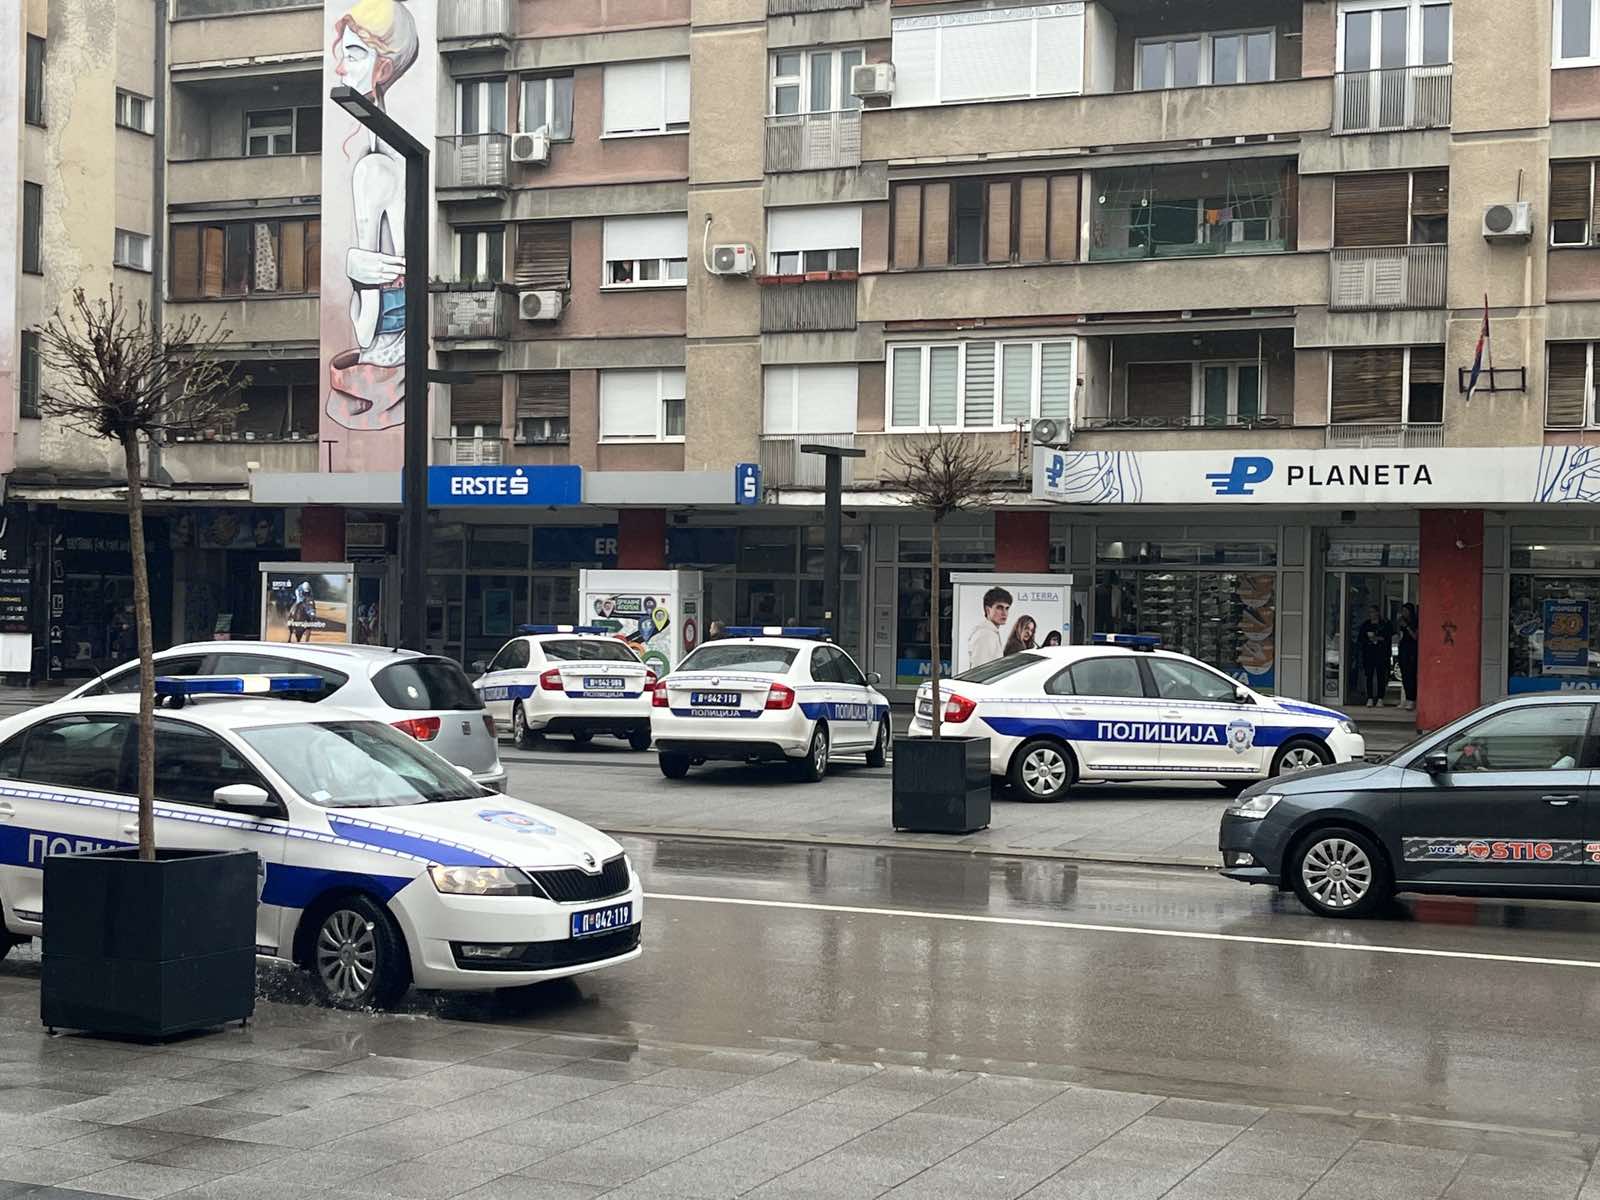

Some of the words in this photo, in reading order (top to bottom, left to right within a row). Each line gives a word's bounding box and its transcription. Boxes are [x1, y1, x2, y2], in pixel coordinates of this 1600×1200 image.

[1286, 464, 1433, 486] PLANETA
[451, 476, 508, 495] ERSTE
[1017, 591, 1028, 600] LA
[1031, 592, 1059, 601] TERRA
[691, 708, 741, 718] ПОЛИЦИЈА
[1097, 721, 1219, 743] ПОЛИЦИЈА
[1429, 845, 1456, 855] VOZI
[1490, 841, 1554, 860] STIG
